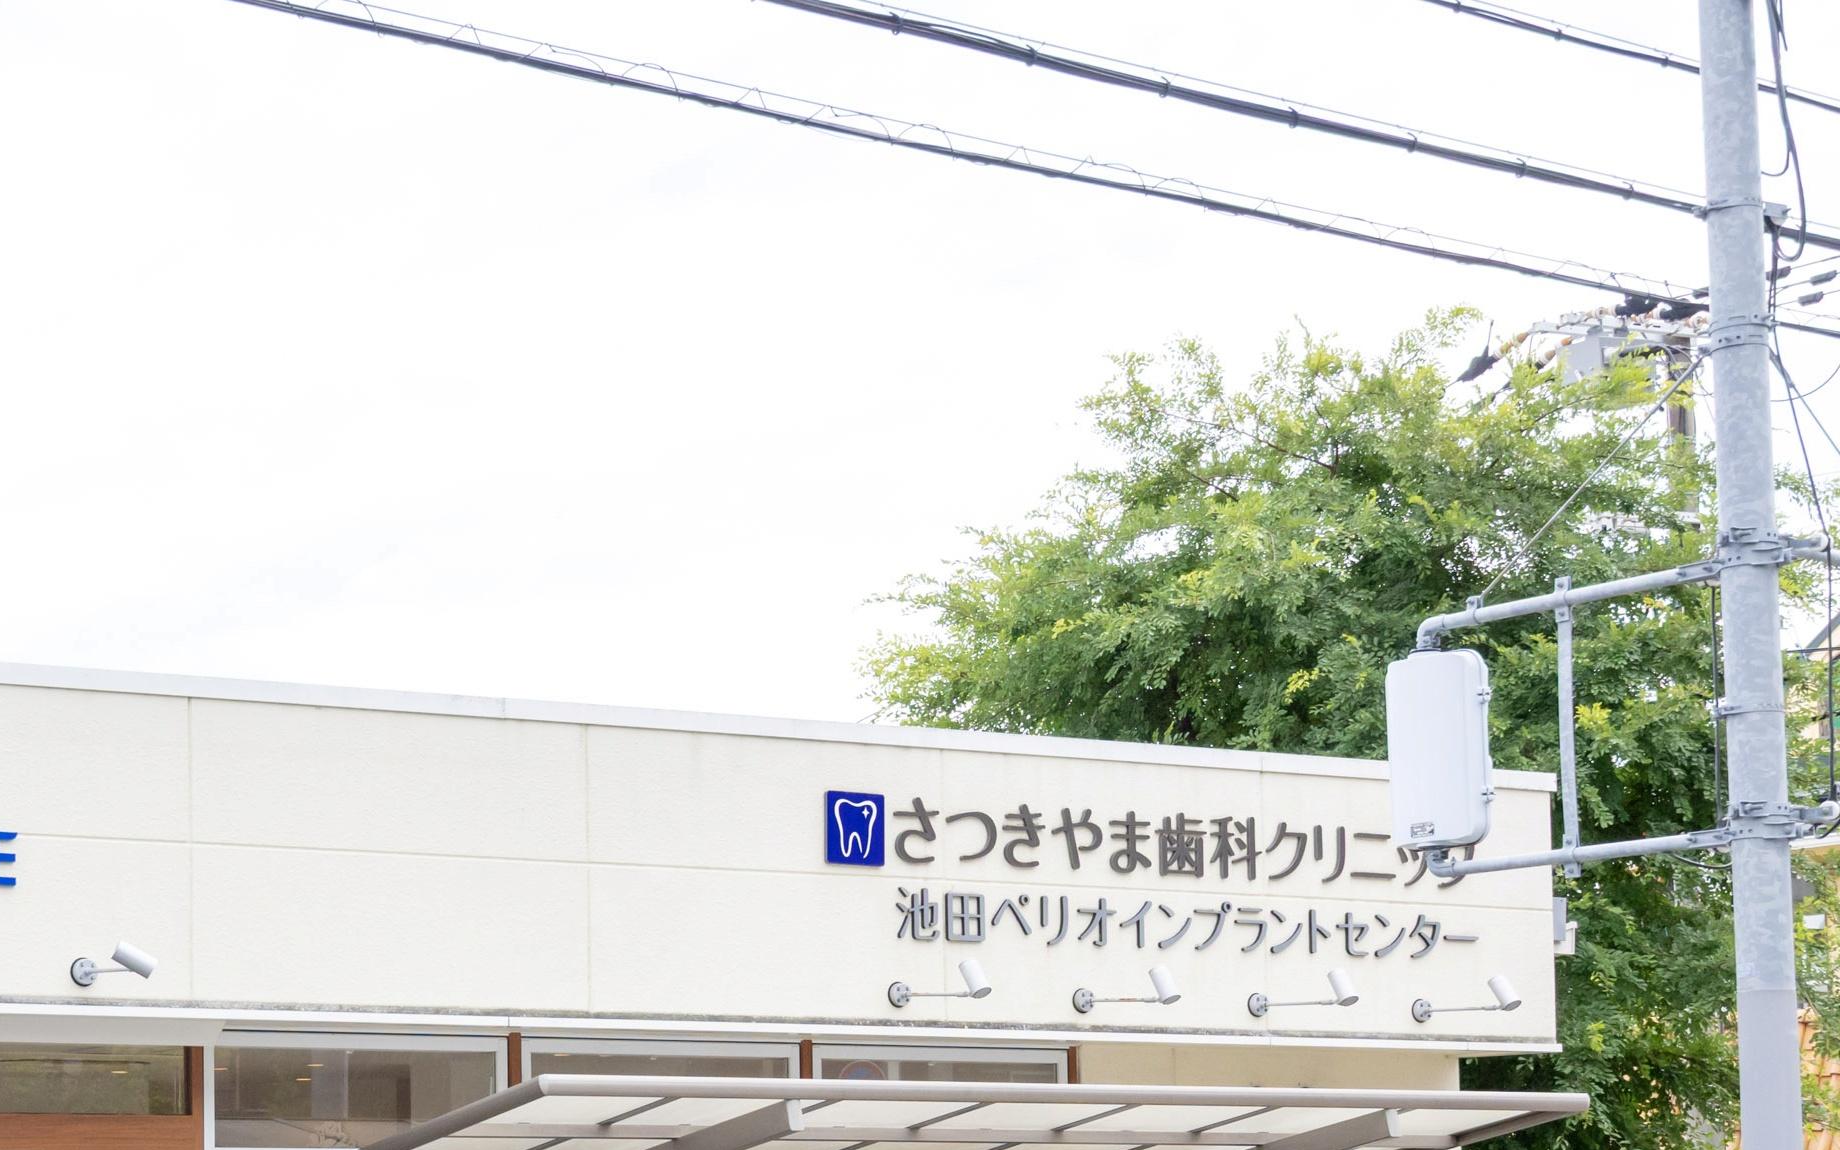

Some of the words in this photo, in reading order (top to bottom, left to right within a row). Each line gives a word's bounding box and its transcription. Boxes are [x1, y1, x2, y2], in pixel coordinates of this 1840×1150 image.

[896, 887, 1479, 959] 池田ペリオインプラントセンター
